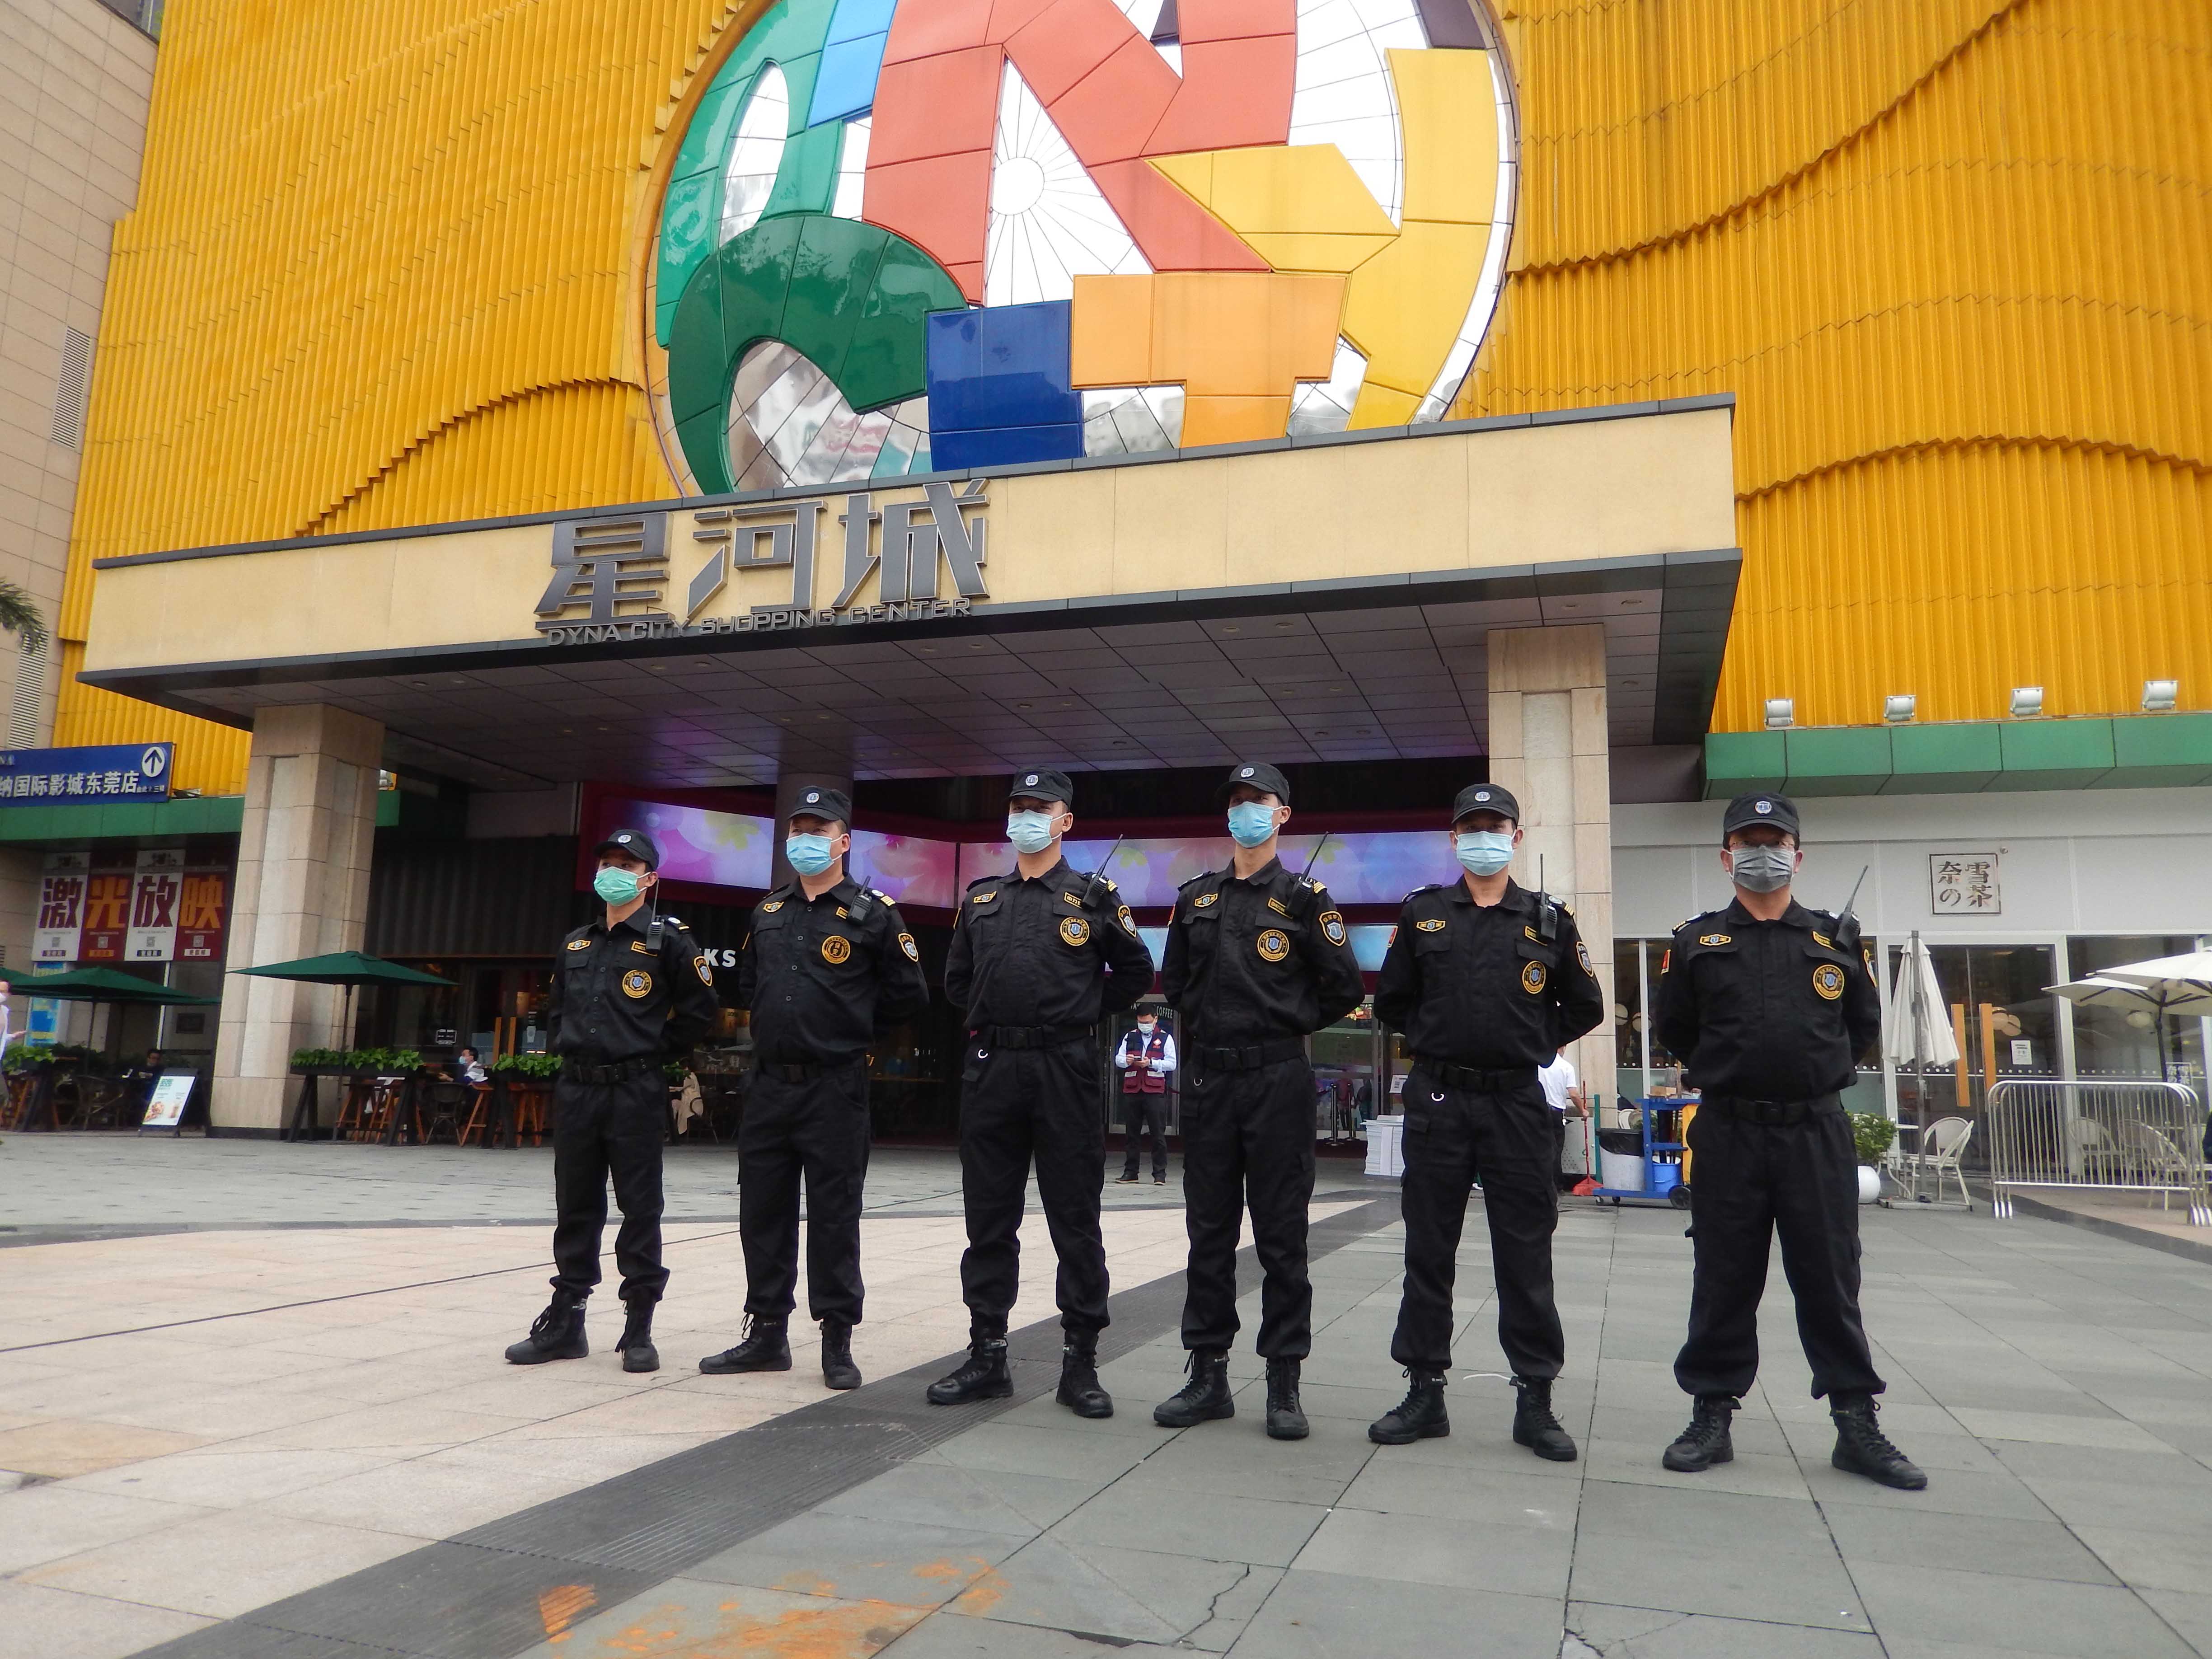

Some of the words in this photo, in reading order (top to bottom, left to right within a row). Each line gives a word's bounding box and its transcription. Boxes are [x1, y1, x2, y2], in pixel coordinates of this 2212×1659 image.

[534, 478, 990, 629] 星河城
[548, 624, 622, 646] DYNA
[631, 619, 690, 640] CITY
[699, 608, 836, 634] SHOPPING
[849, 597, 971, 624] CENTER
[1938, 861, 1991, 884] 奈雪
[39, 874, 224, 929] 激光放映
[1939, 884, 1992, 908] の茶
[699, 948, 736, 967] KS
[1157, 1006, 1173, 1019] COFFEE
